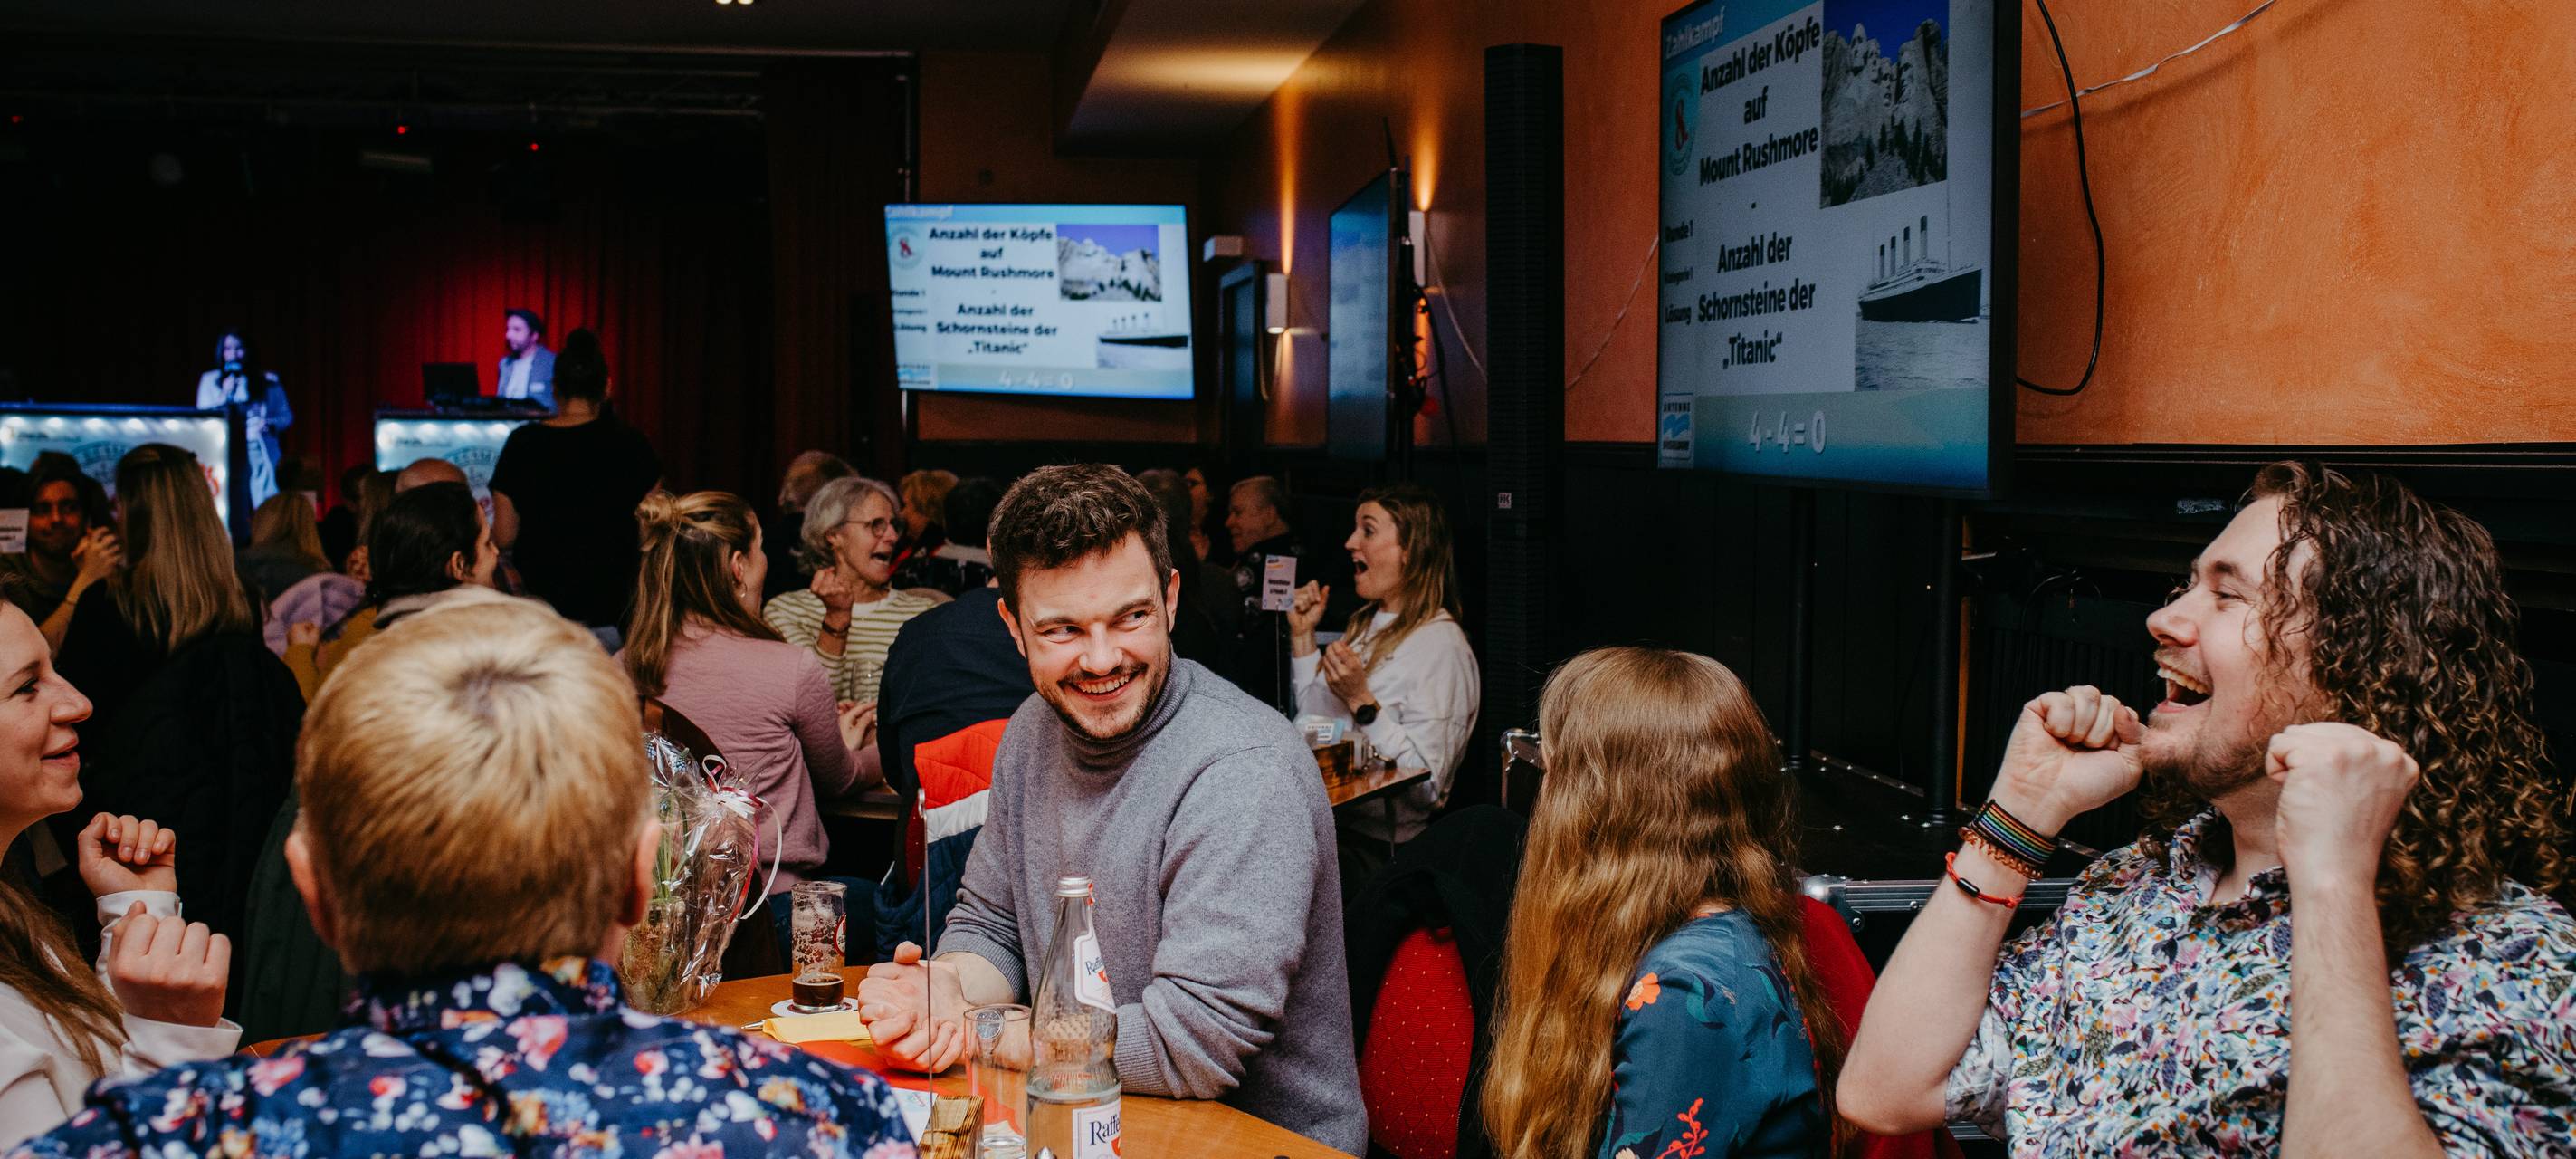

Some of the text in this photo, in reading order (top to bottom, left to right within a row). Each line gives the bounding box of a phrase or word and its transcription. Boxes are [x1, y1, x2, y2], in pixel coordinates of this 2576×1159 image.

[1701, 16, 1820, 95] Anzahl der Köpfe
[1744, 85, 1769, 124] auf
[1700, 127, 1818, 186] Mount Rushmore
[929, 228, 1053, 243] Anzahl der Köpfe
[980, 247, 1003, 259] auf
[1717, 232, 1792, 273] Anzahl der
[931, 266, 1055, 278] Mount Rushmore
[957, 304, 1035, 316] Anzahl der
[1665, 304, 1692, 325] Lösung
[1698, 278, 1816, 323] Schornsteine der
[936, 321, 1058, 336] Schornsteine der
[1722, 330, 1782, 369] „Titanic“
